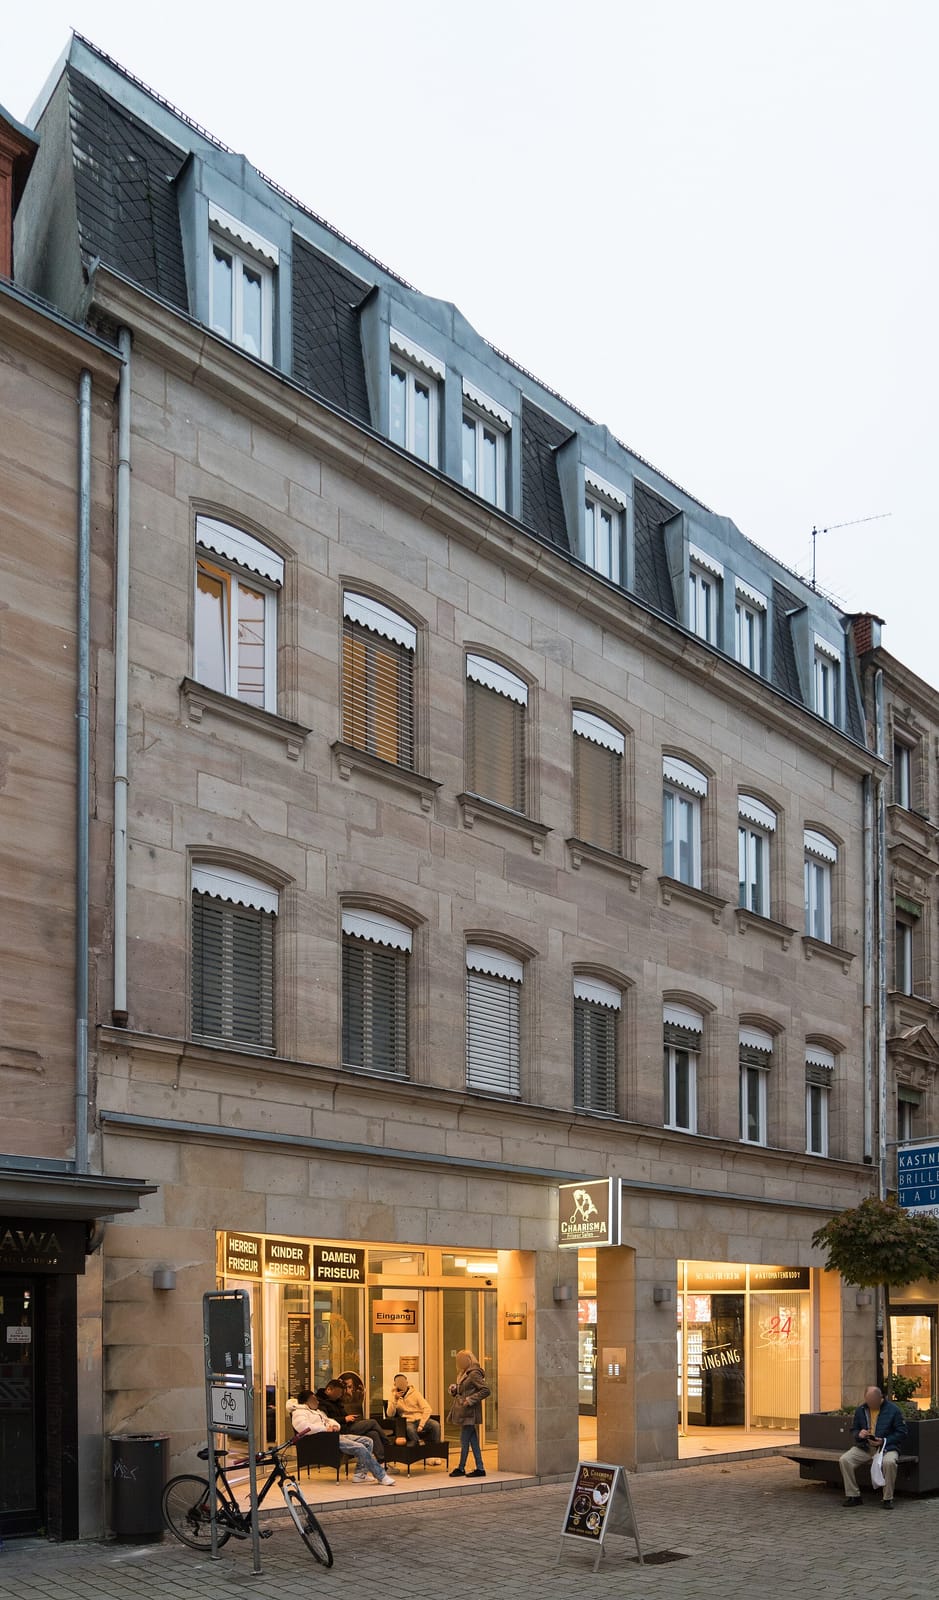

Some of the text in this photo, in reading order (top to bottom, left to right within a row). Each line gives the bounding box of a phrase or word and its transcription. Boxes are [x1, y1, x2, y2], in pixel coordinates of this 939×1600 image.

[229, 1238, 258, 1255] HERREN
[271, 1245, 304, 1260] KINDER
[228, 1256, 259, 1273] FRISEUR
[321, 1250, 357, 1264] DAMEN
[268, 1262, 306, 1277] FRISEUR
[317, 1266, 360, 1280] FRISEUR
[376, 1312, 411, 1321] Eingang
[768, 1316, 792, 1338] 24
[700, 1349, 741, 1371] EINGANG
[224, 1412, 234, 1422] frei
